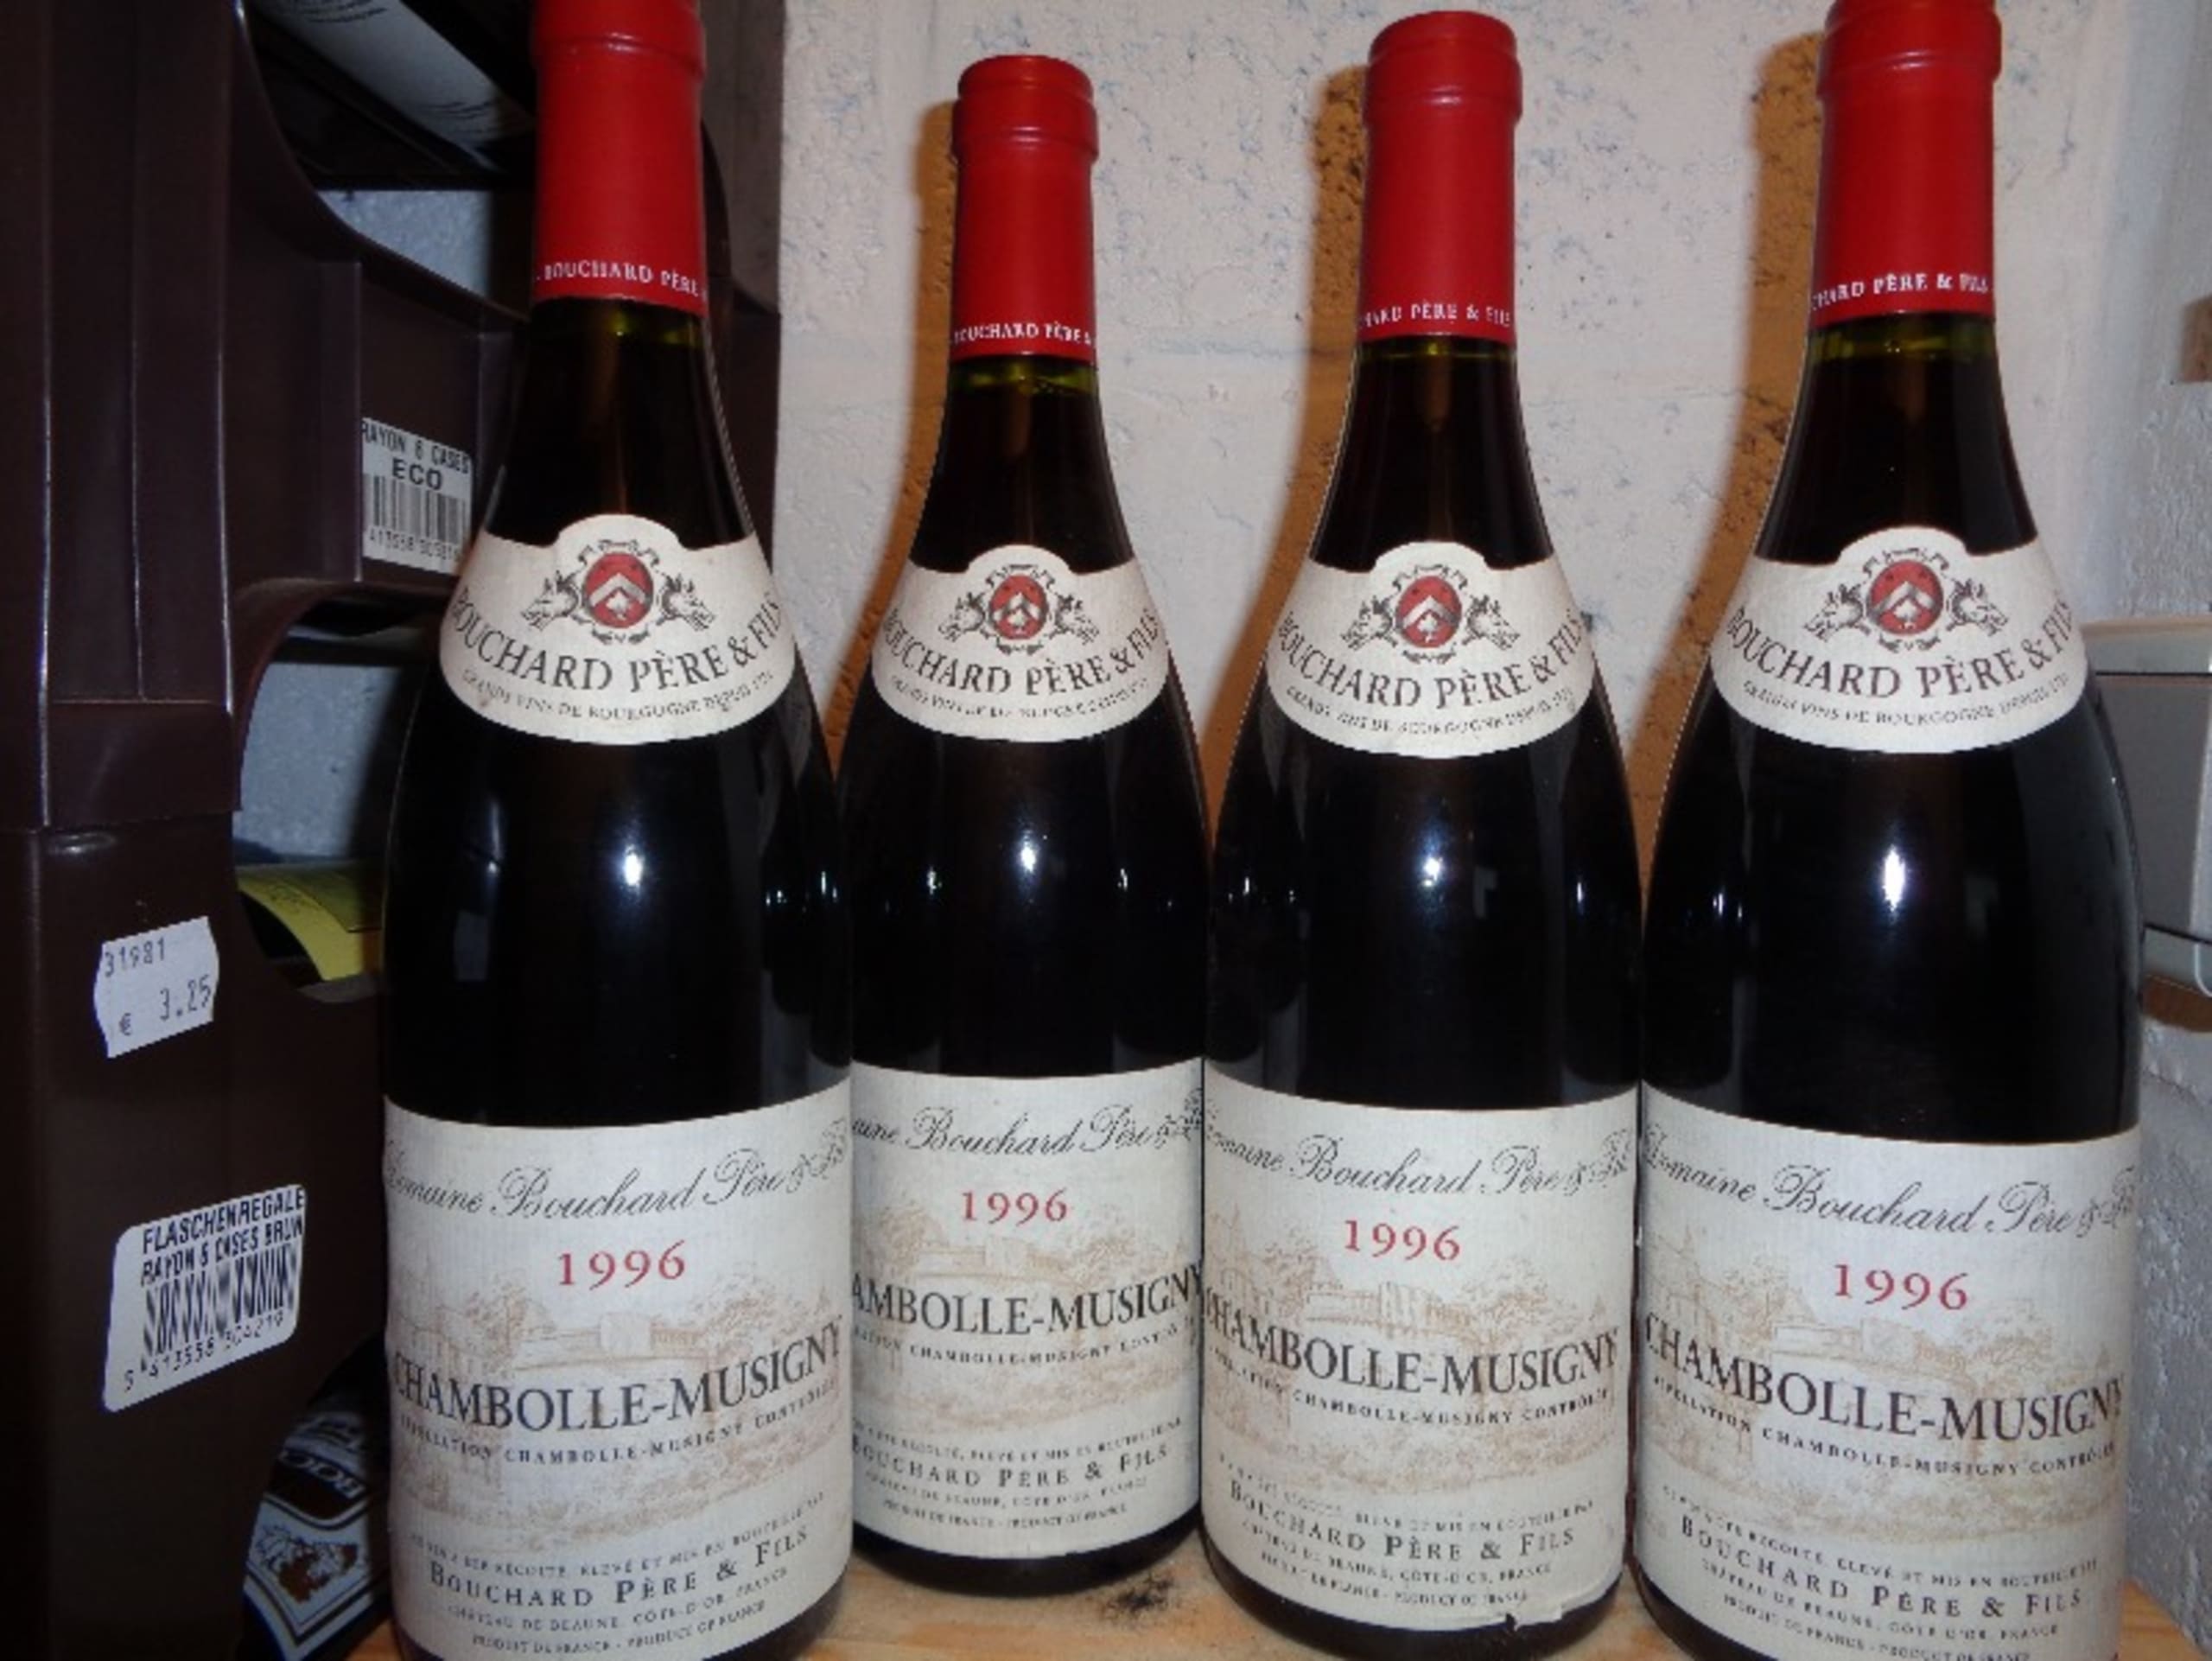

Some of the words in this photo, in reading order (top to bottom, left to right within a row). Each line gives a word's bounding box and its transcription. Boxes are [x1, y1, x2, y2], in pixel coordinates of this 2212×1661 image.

[393, 458, 442, 491] ECO
[448, 586, 613, 691] BOUCHARD
[628, 649, 728, 692] PÈRE
[730, 634, 757, 667] &
[882, 608, 1012, 694] BOUCHARD
[1026, 658, 1111, 696] PÈRE
[1114, 647, 1137, 674] &
[1278, 610, 1421, 708] BOUCHARD
[1435, 668, 1532, 710] PÈRE
[1534, 654, 1558, 684] &
[1726, 605, 1901, 698] BOUCHARD
[1915, 655, 2024, 699] PÈRE
[2027, 637, 2054, 672] &
[160, 973, 212, 1021] 3.25
[905, 1106, 1084, 1156] Bouchard
[1079, 1103, 1153, 1153] Père
[1288, 1134, 1483, 1195] Bouchard
[1479, 1144, 1560, 1195] Père
[488, 1167, 708, 1219] Bouchard
[702, 1147, 785, 1205] Père
[962, 1187, 1068, 1227] 1996
[1762, 1163, 1990, 1234] Bouchard
[1985, 1179, 2076, 1234] Père
[143, 1187, 305, 1255] FLASCHENREGALE
[1344, 1219, 1461, 1262] 1996
[557, 1238, 687, 1291] 1996
[851, 1263, 1203, 1335] AMBOLLE-MUSIGNY
[1834, 1262, 1969, 1311] 1996
[394, 1315, 843, 1433] CHAMBOLLE-MUSIGNY
[1206, 1285, 1620, 1397] CHAMBOLLE-MUSIGNY
[1644, 1311, 2125, 1441] CHAMBOLLE-MUSIGNY
[1084, 1460, 1103, 1481] &
[1120, 1441, 1168, 1473] FILS
[1761, 1427, 2018, 1477] CHAMBOLLE-MUSIGNY
[1230, 1480, 1366, 1551] BOUCHARD
[1384, 1532, 1462, 1562] PÈRE
[1479, 1540, 1502, 1561] &
[1520, 1527, 1575, 1556] FILS
[431, 1559, 594, 1607] BOUCHARD
[615, 1571, 696, 1604] PÈRE
[715, 1558, 738, 1582] &
[754, 1524, 808, 1569] FILS
[1681, 1513, 1848, 1600] BOUCHARD
[1871, 1583, 1961, 1618] PÈRE
[1980, 1595, 2005, 1618] &
[2025, 1587, 2082, 1616] FILS
